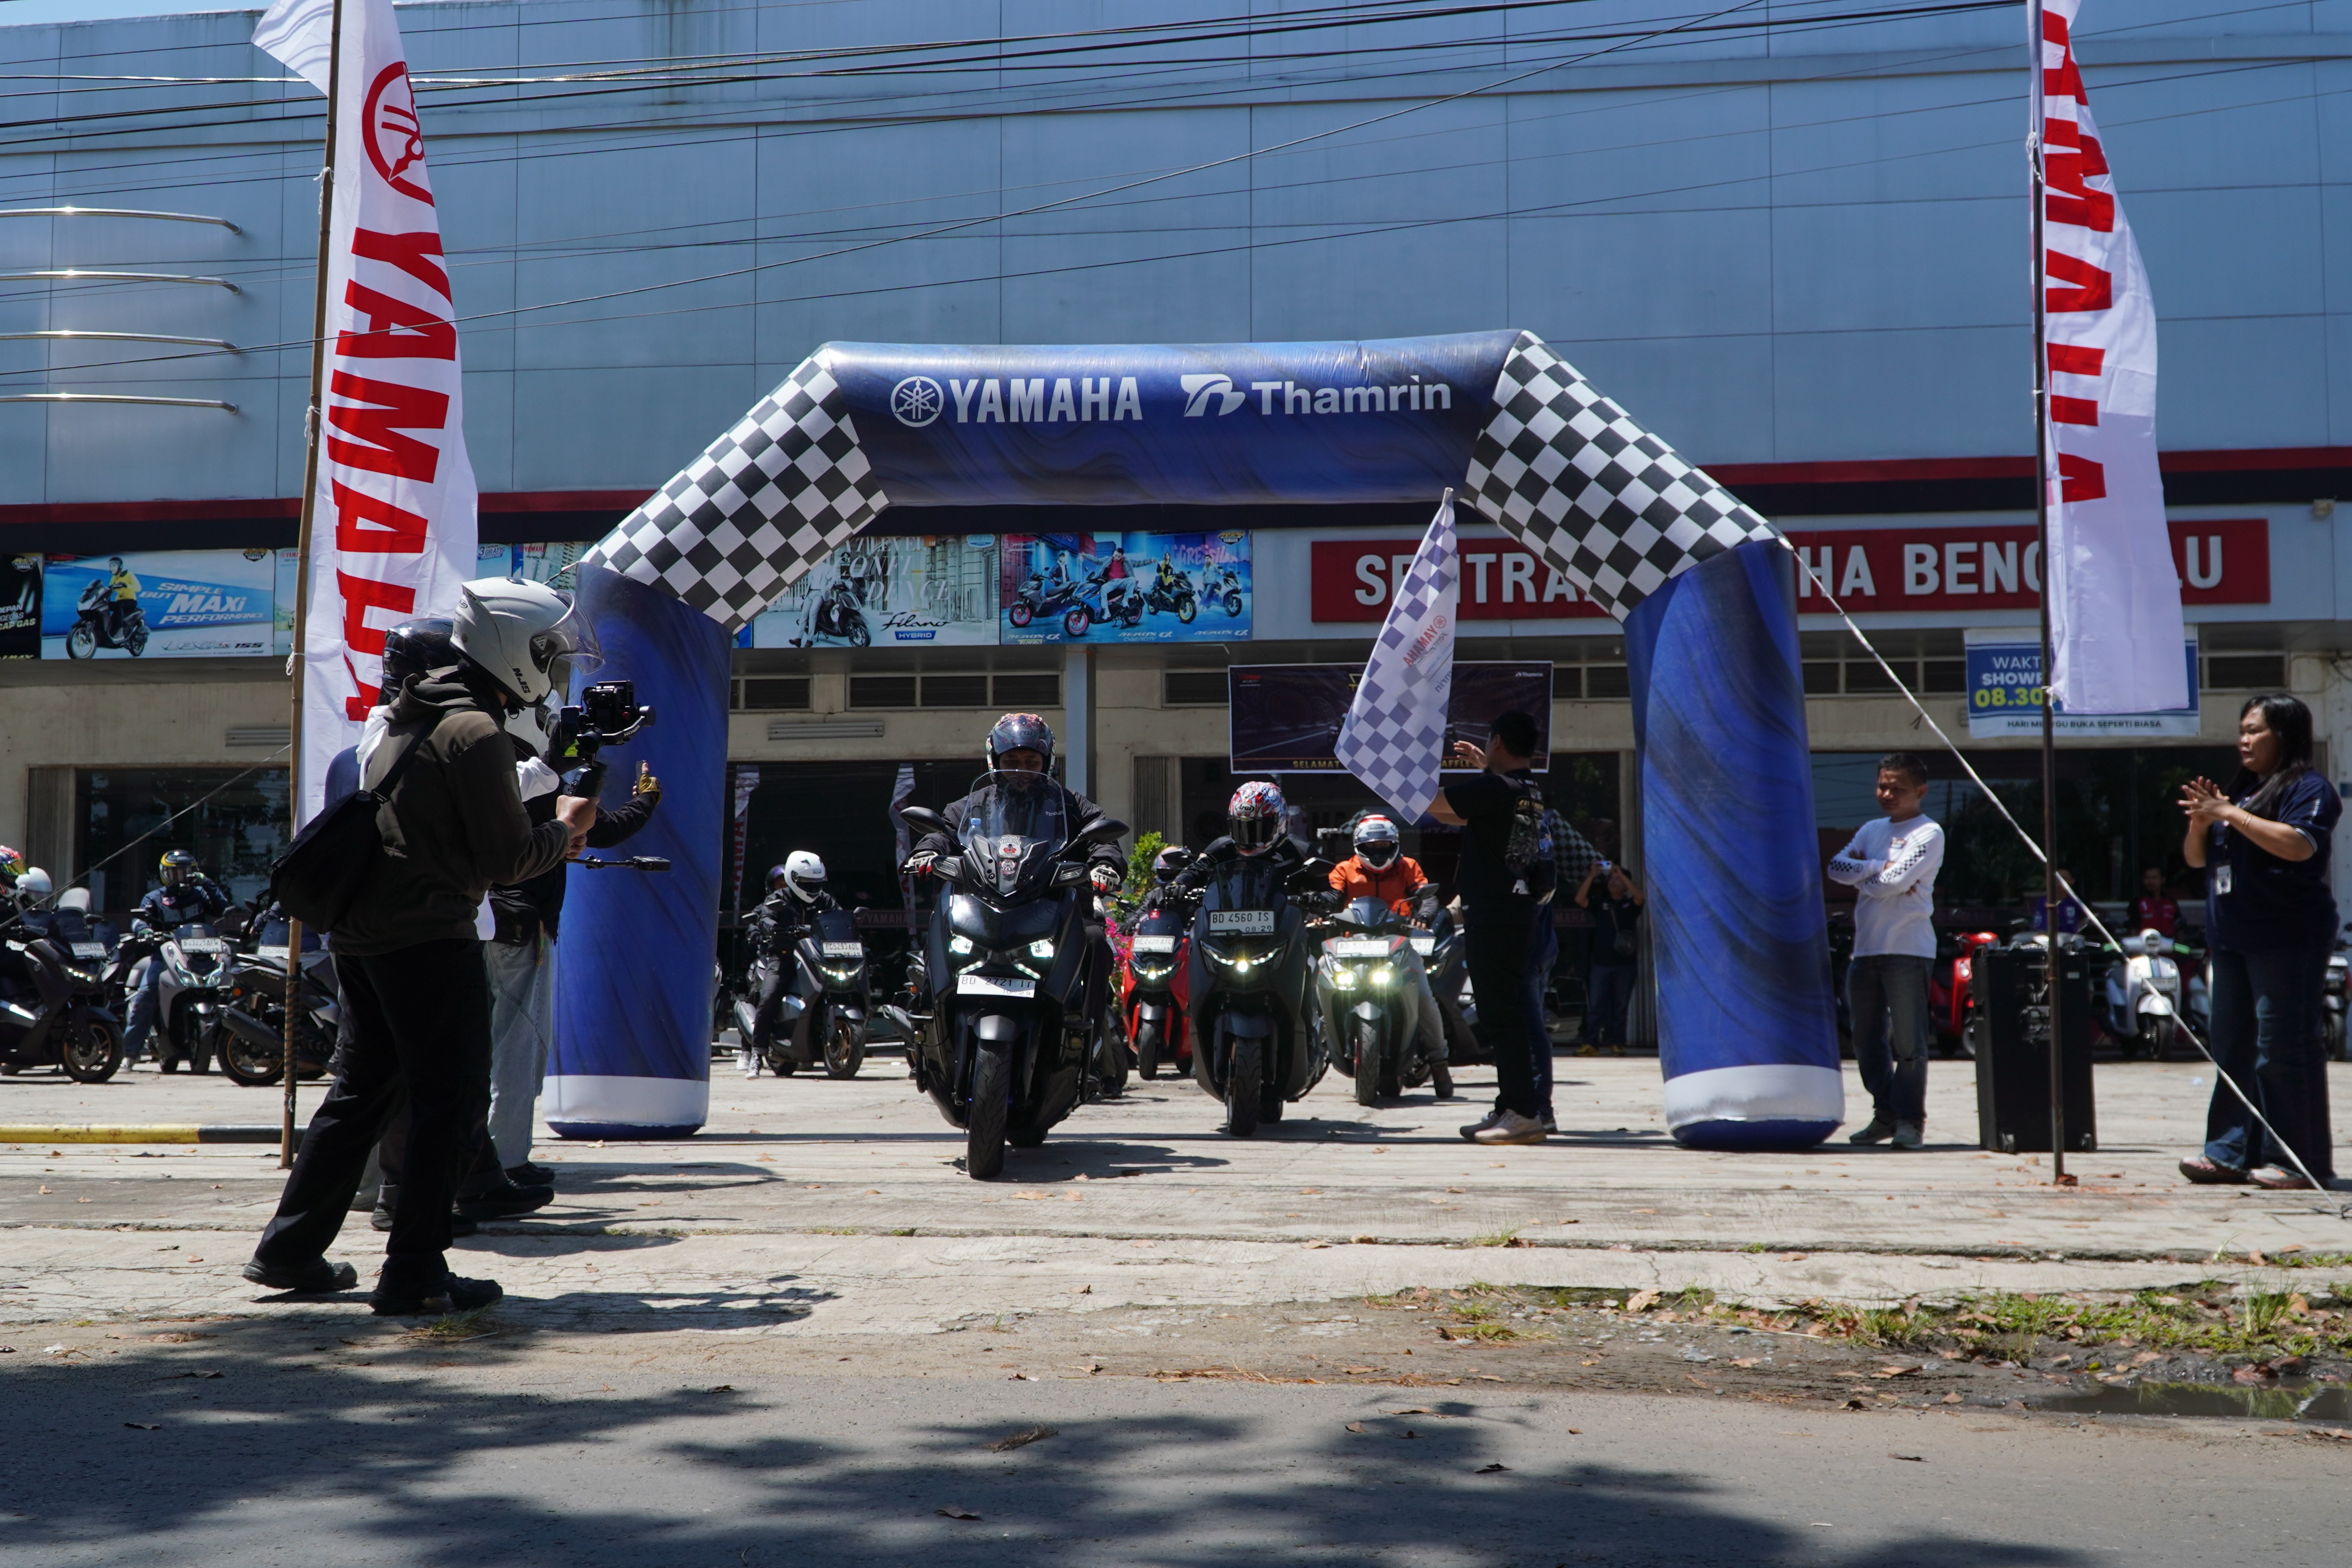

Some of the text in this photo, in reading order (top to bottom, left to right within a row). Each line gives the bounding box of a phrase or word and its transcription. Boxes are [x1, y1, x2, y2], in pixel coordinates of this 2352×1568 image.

[950, 375, 1452, 423] YAMAHA Thamrin
[479, 547, 484, 556] 3
[158, 582, 225, 595] SIMPLE
[16, 618, 36, 627] GAS
[158, 612, 264, 625] PERFORMANCE
[1993, 656, 2041, 669] WAKT
[512, 668, 531, 693] NJS
[1292, 760, 1340, 769] SELAMAT
[1213, 912, 1269, 923] BD 4560 IS
[961, 976, 976, 985] BD
[985, 977, 1013, 987] 2721
